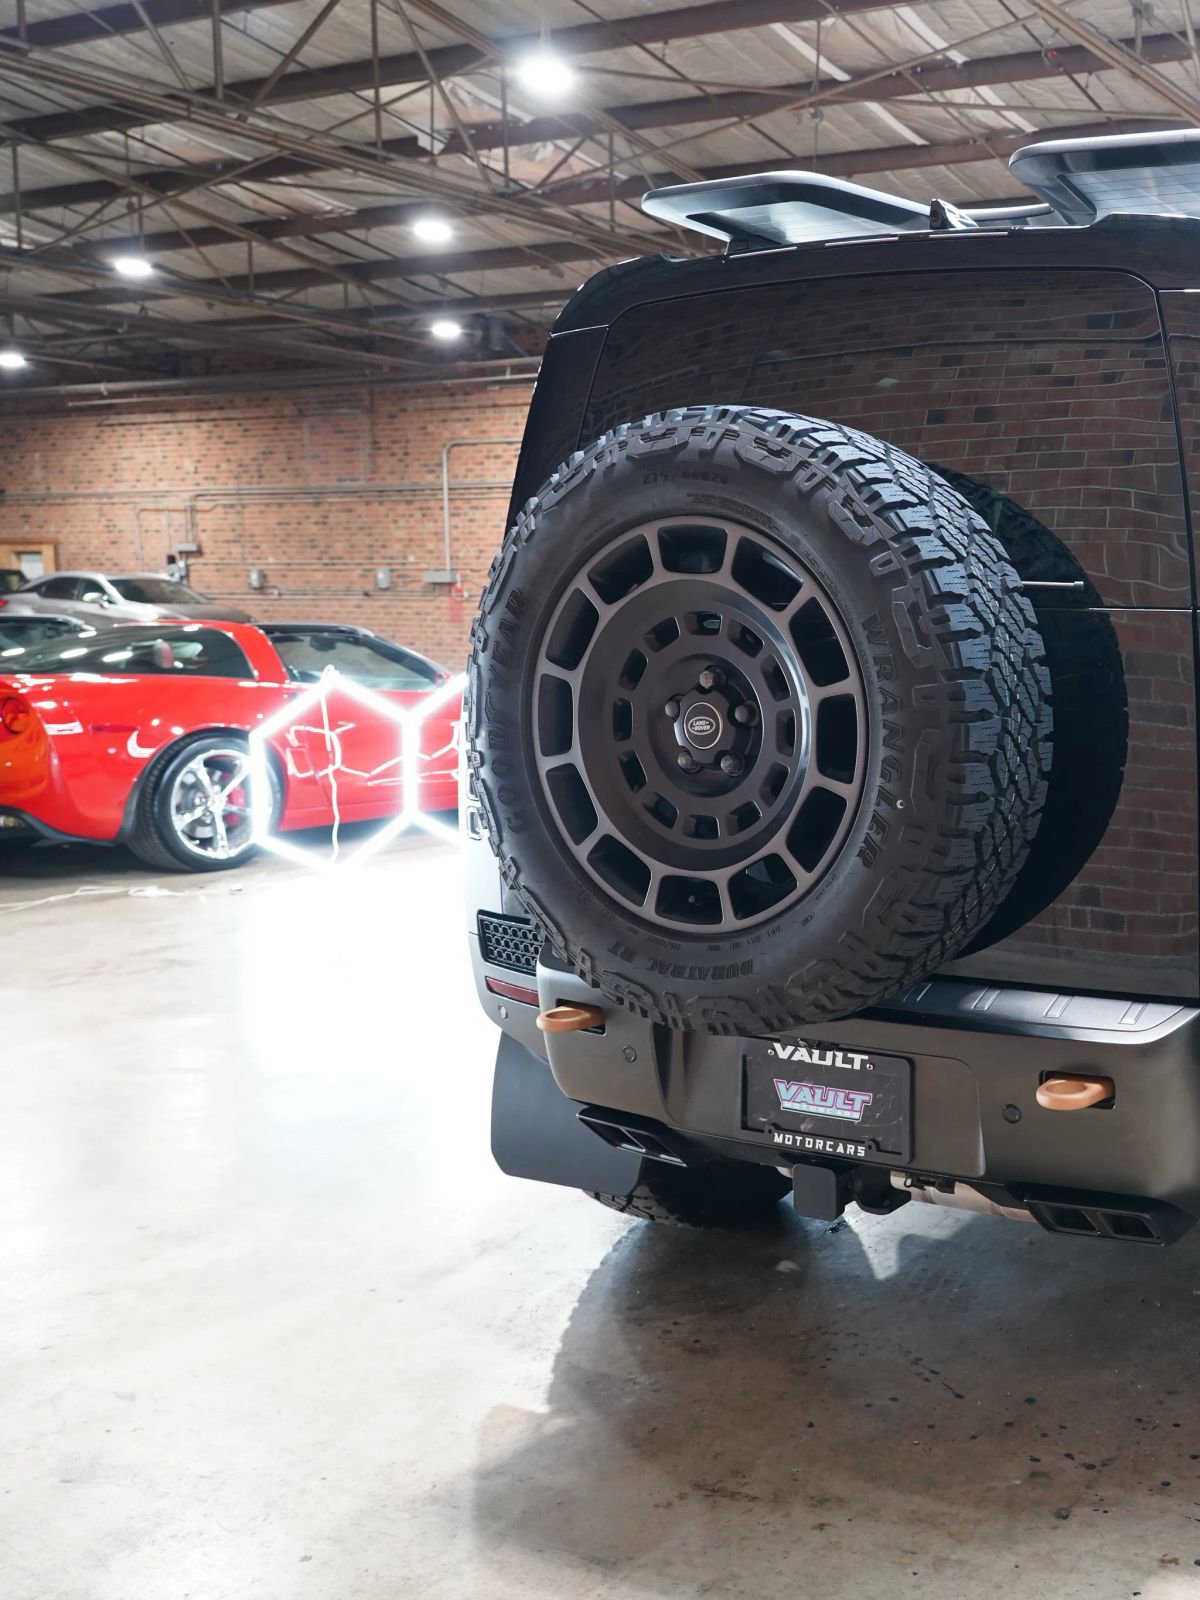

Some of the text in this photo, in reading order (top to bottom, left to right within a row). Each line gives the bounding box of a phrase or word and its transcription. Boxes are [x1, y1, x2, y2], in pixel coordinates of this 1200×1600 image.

[484, 587, 528, 833] GOODYEAR
[857, 610, 904, 870] WRANGLER
[773, 1043, 869, 1070] VAULT
[774, 1079, 872, 1112] VAULT
[773, 1132, 866, 1157] MOTORCARS
